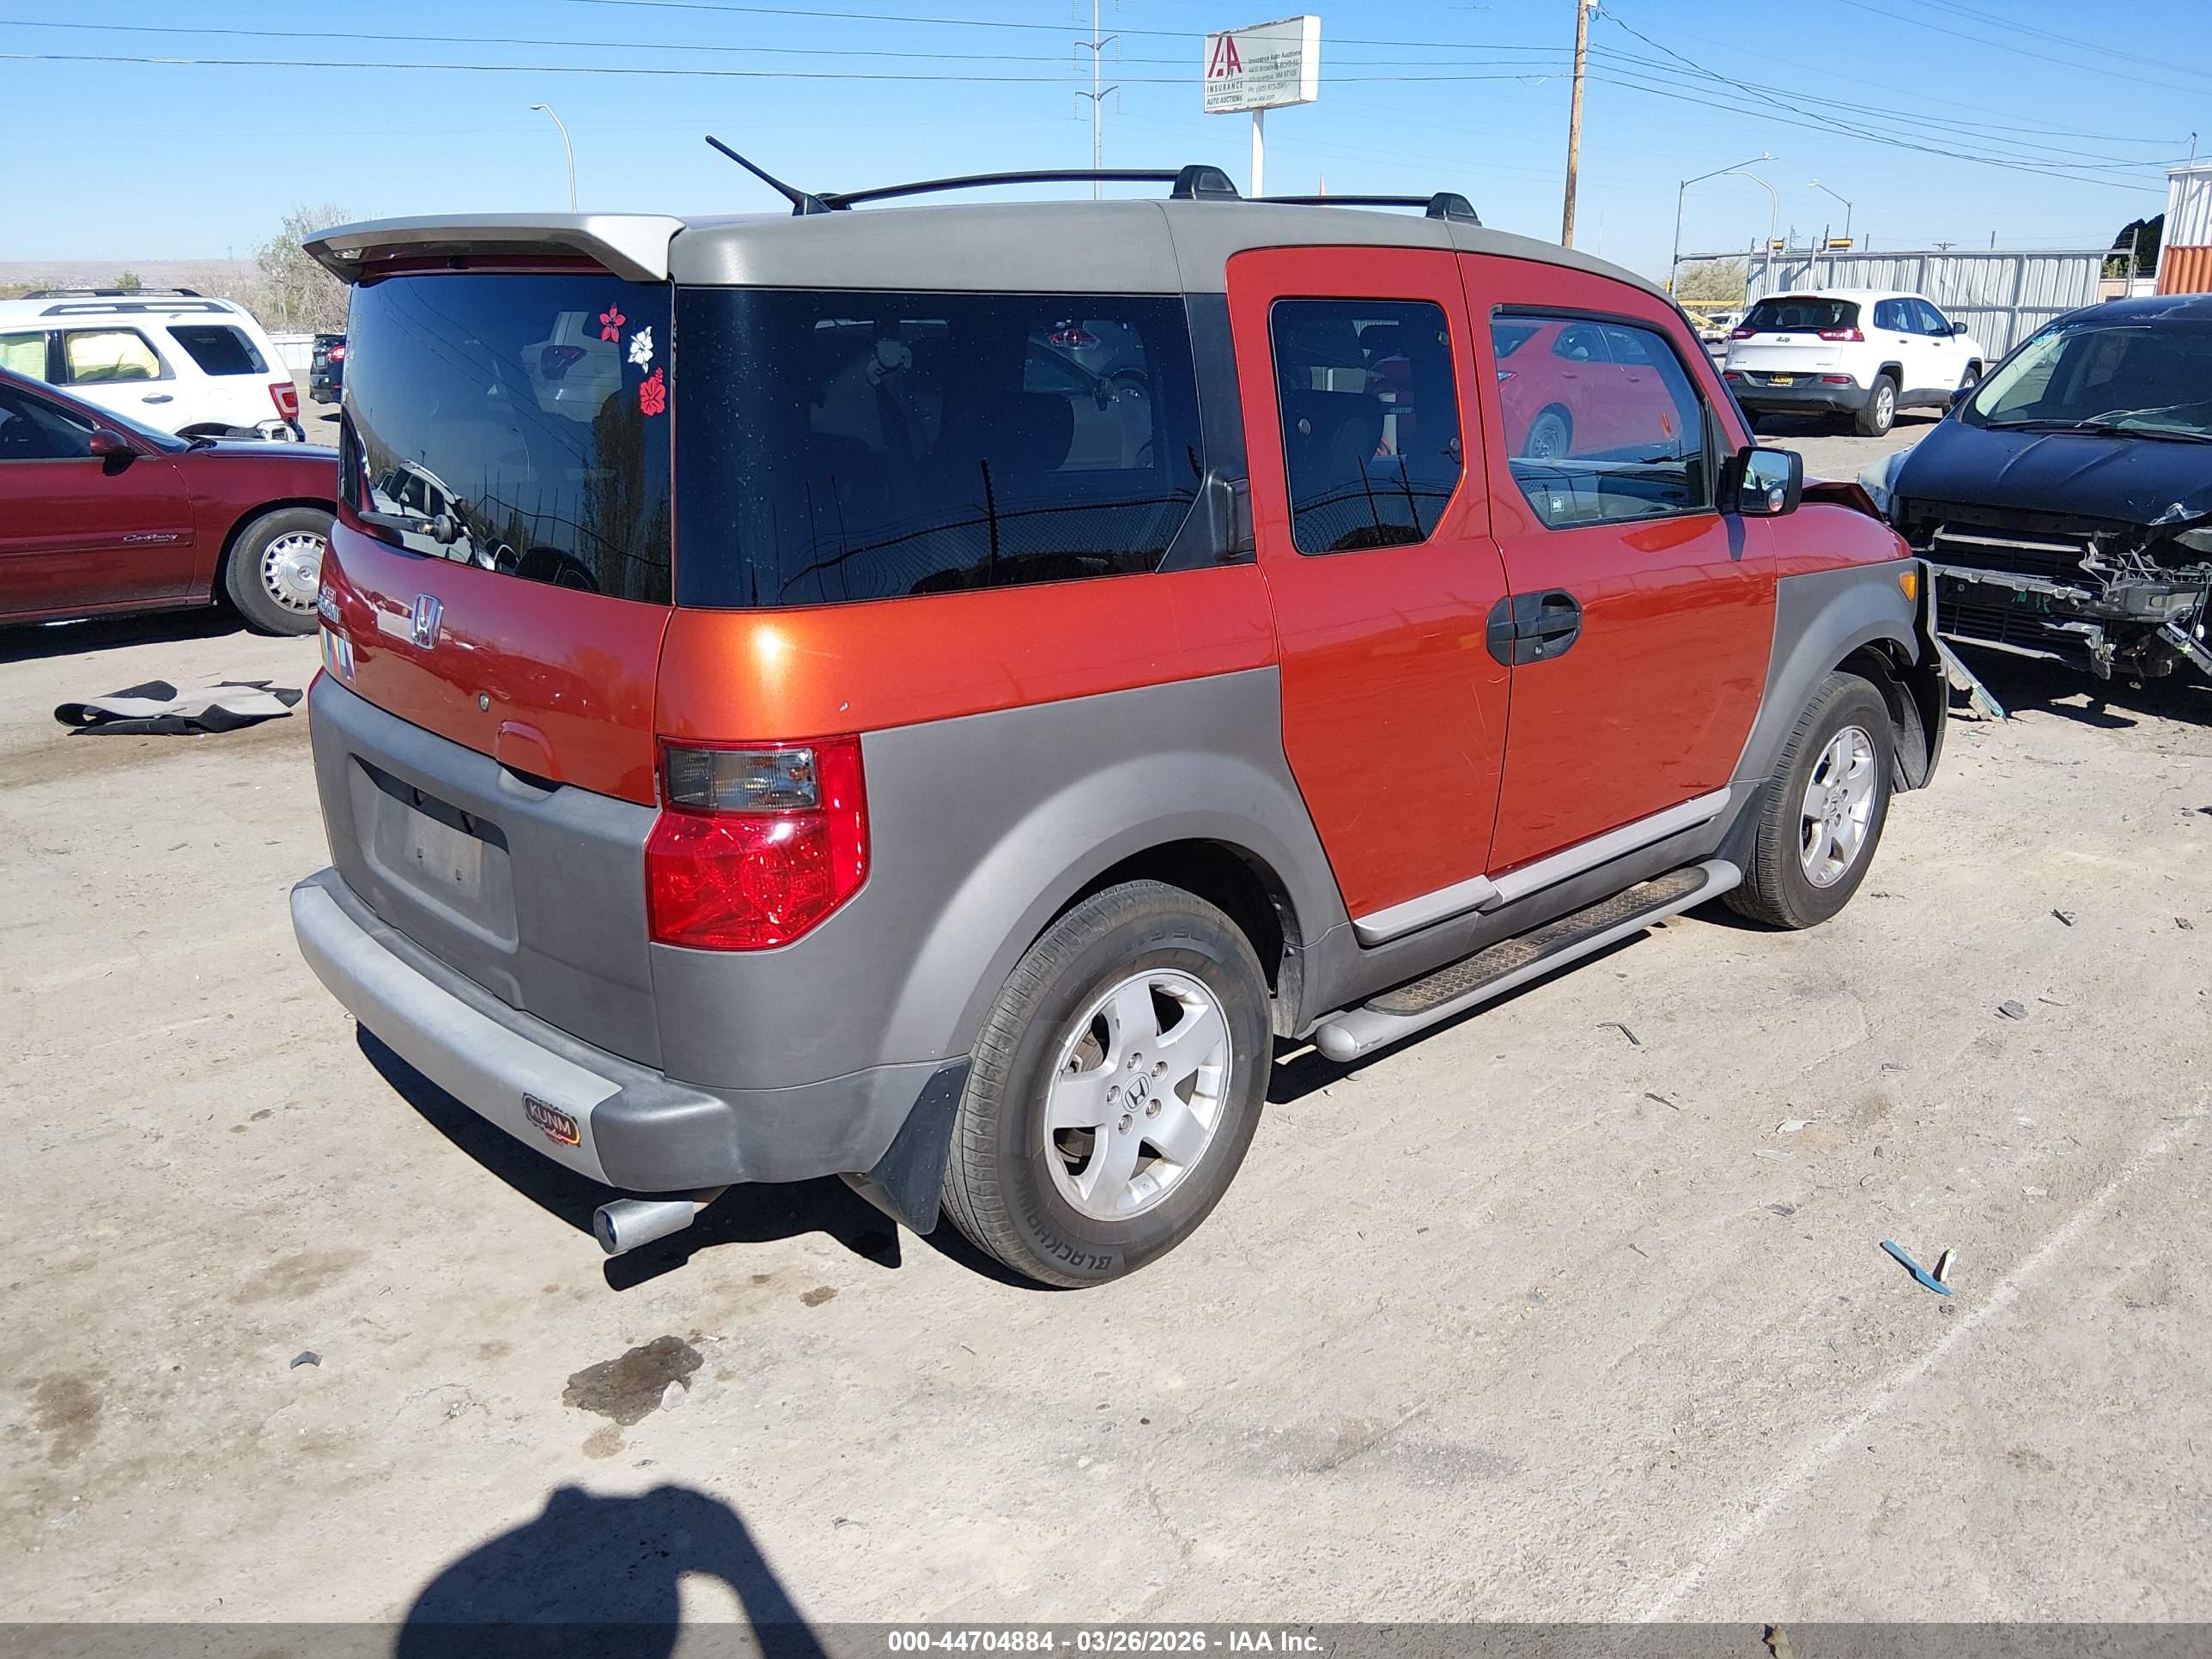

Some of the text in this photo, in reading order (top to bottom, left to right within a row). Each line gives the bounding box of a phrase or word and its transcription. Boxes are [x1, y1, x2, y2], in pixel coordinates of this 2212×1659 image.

[1206, 82, 1243, 94] INSURANCE
[1206, 94, 1243, 106] AUTO AUCTIONS
[529, 1102, 572, 1135] KUNM
